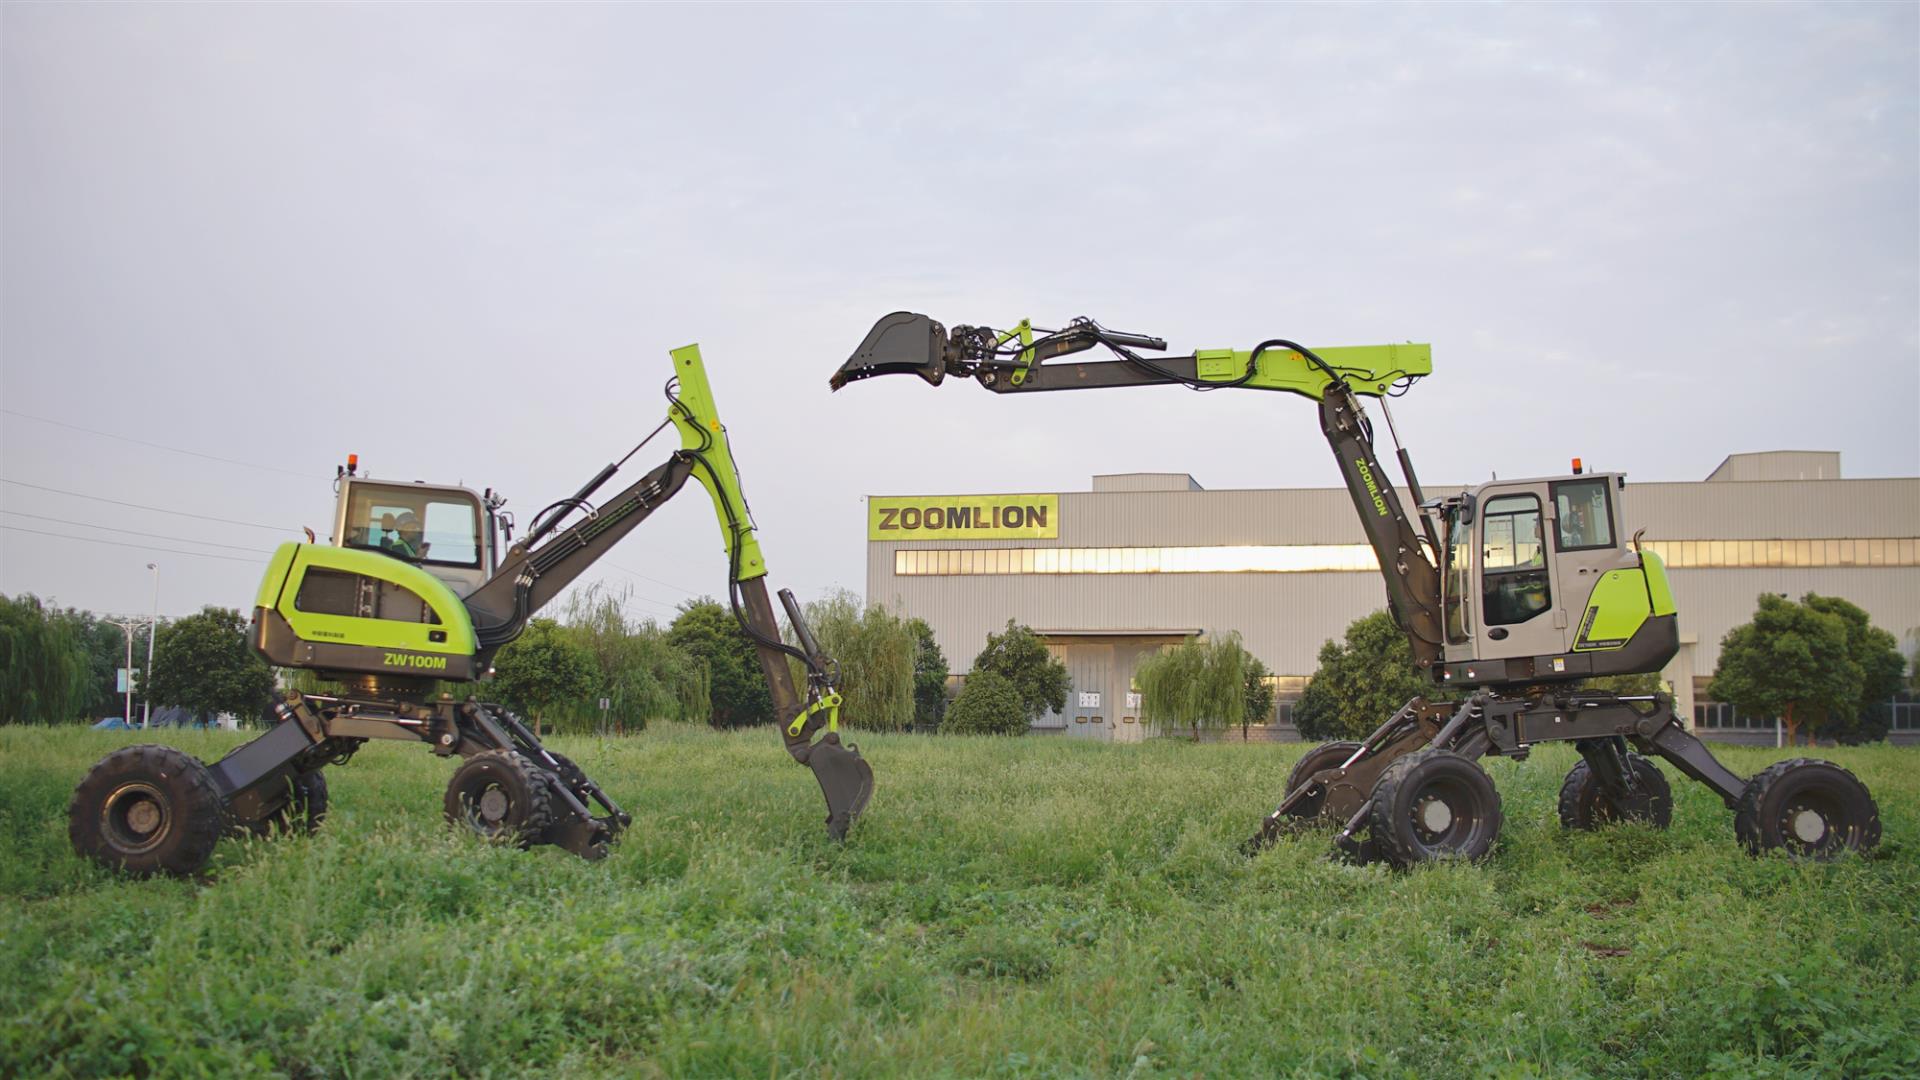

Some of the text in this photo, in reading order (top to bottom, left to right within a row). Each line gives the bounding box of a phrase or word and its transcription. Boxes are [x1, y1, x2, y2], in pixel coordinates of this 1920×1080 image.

[1355, 457, 1388, 516] ZOOMLION
[878, 505, 1048, 530] ZOOMLION
[384, 652, 447, 669] ZW100M
